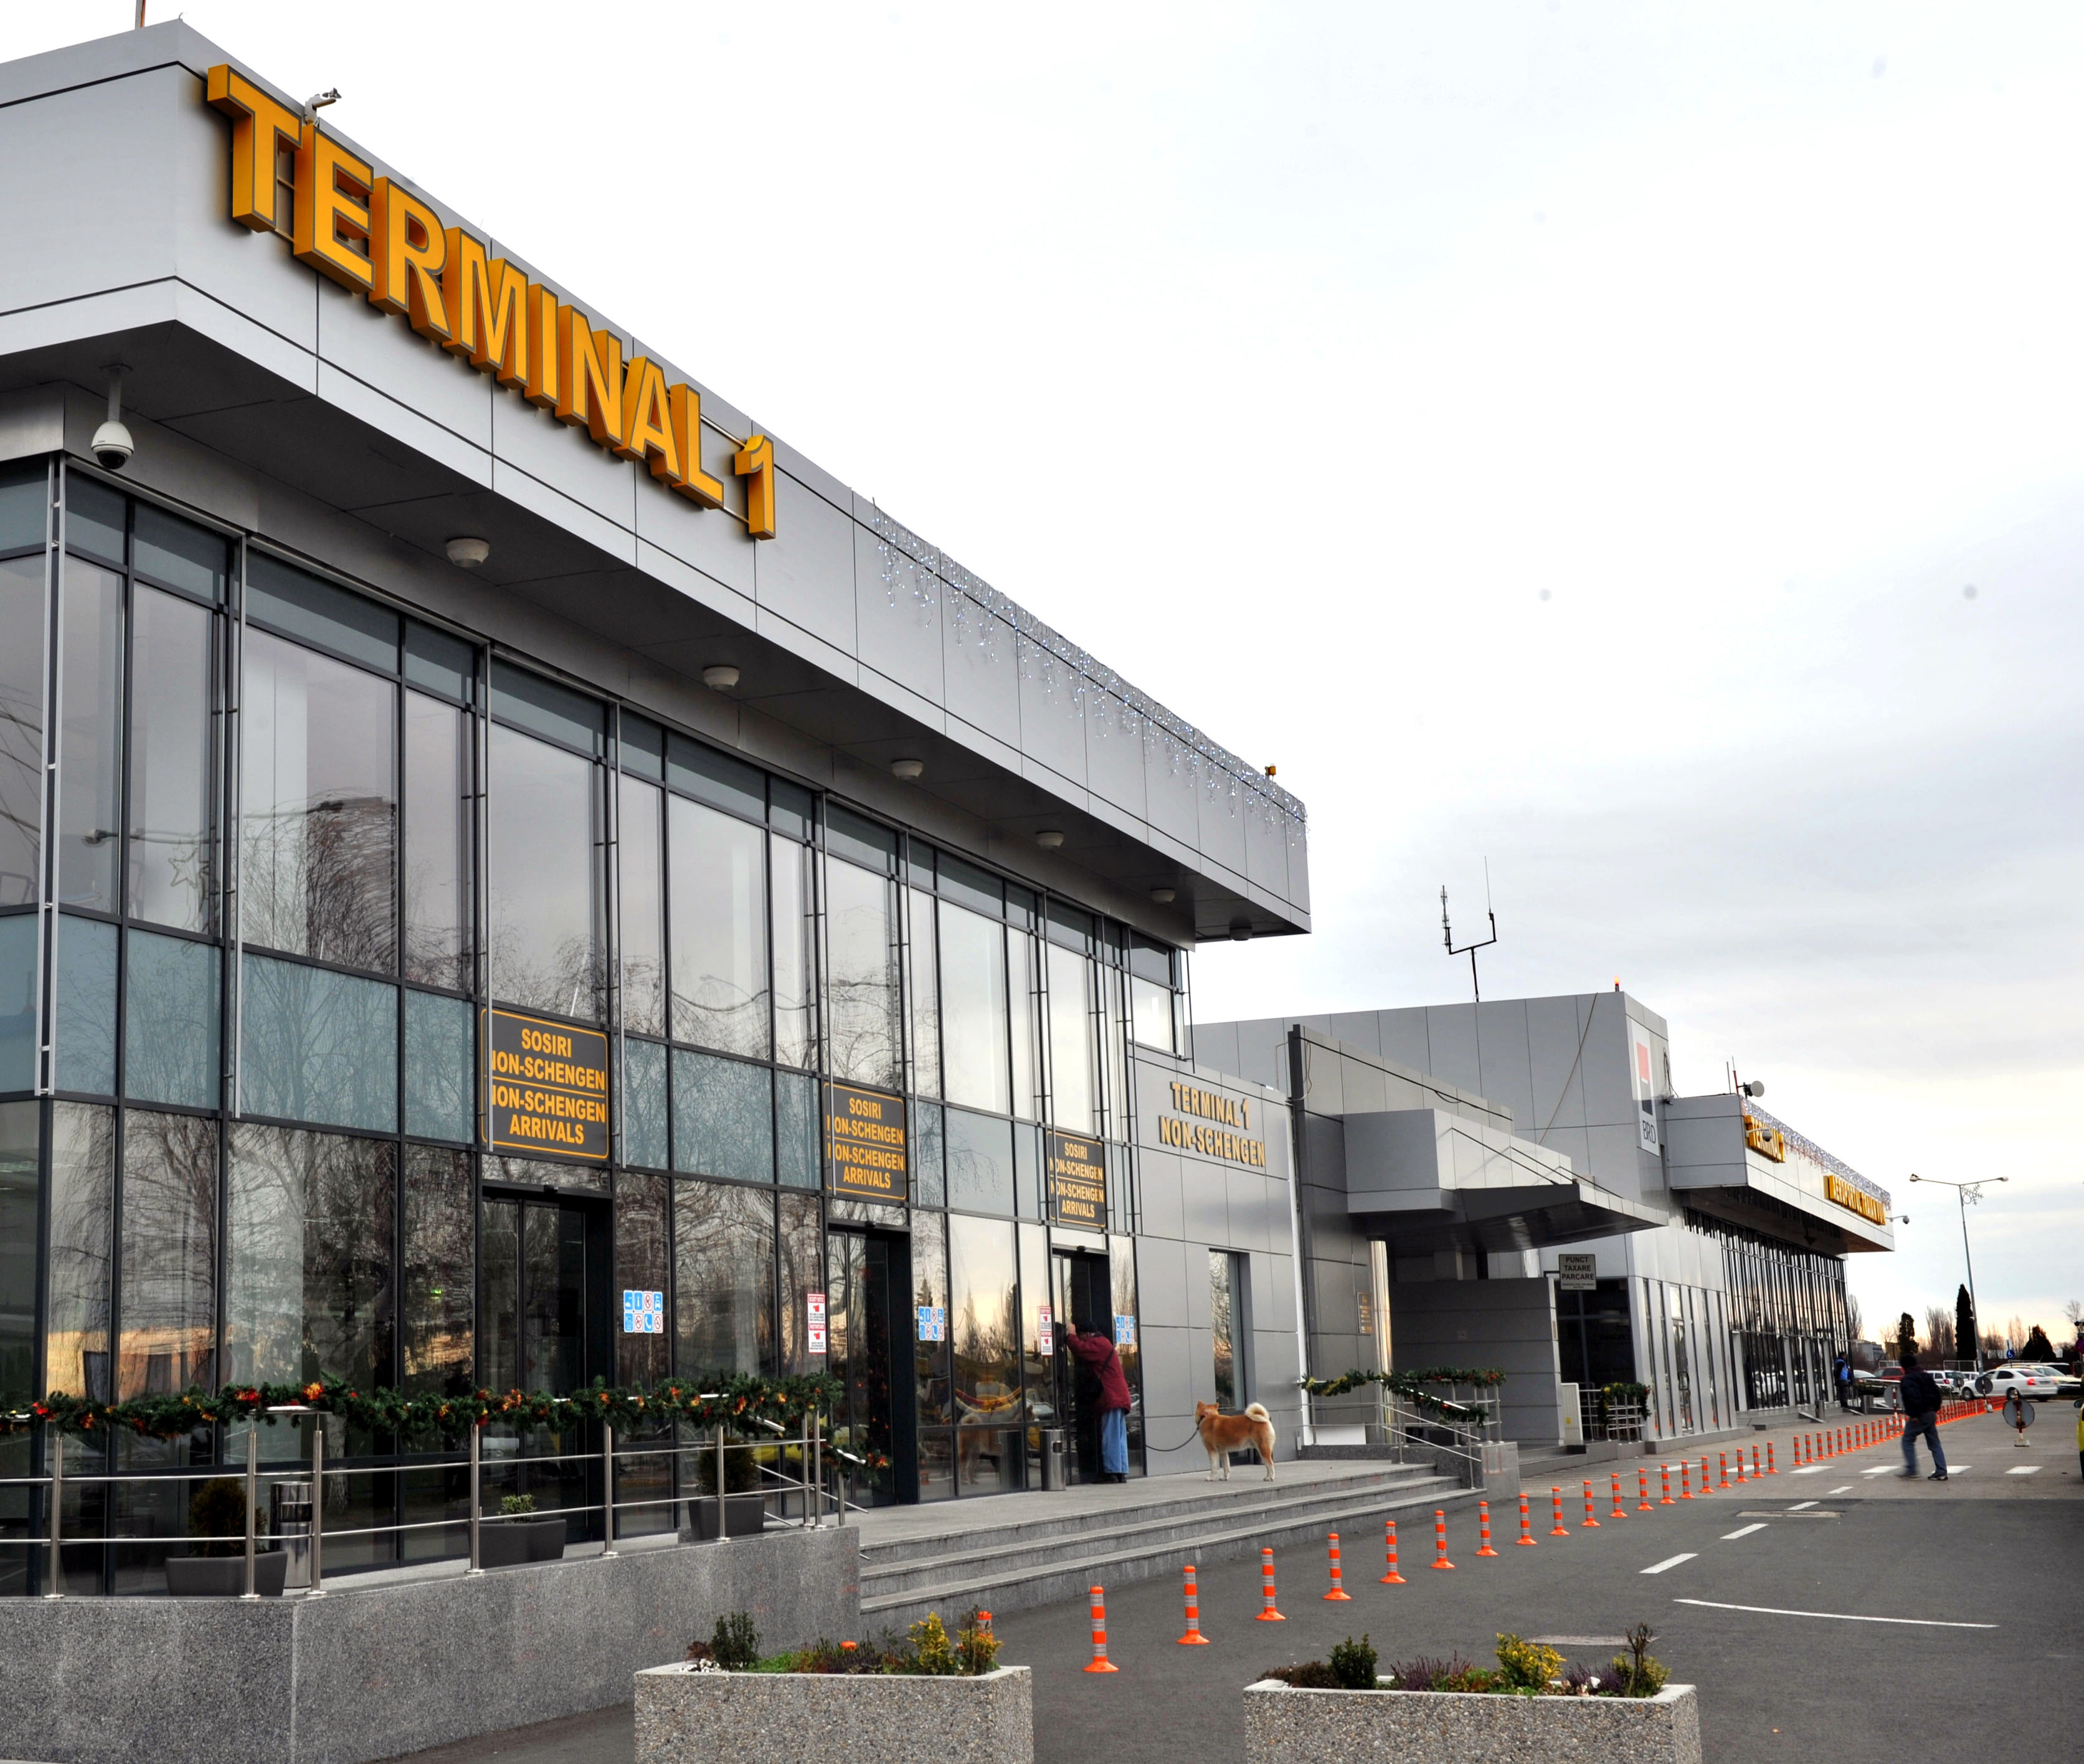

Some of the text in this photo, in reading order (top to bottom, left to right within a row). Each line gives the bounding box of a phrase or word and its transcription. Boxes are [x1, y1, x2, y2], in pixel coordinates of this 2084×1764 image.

[207, 64, 775, 540] TERMINAL 1
[521, 1028, 572, 1058] SOSIRI
[849, 1097, 881, 1119] SOSIRI
[1170, 1081, 1250, 1130] TERMINAL 1
[509, 1114, 585, 1145] ARRIVALS
[1158, 1115, 1266, 1167] NON-SCHENGEN
[1642, 1120, 1656, 1144] BRD
[1064, 1142, 1087, 1160] SOSIRI
[843, 1166, 891, 1188] ARRIVALS
[1061, 1200, 1095, 1218] ARRIVALS
